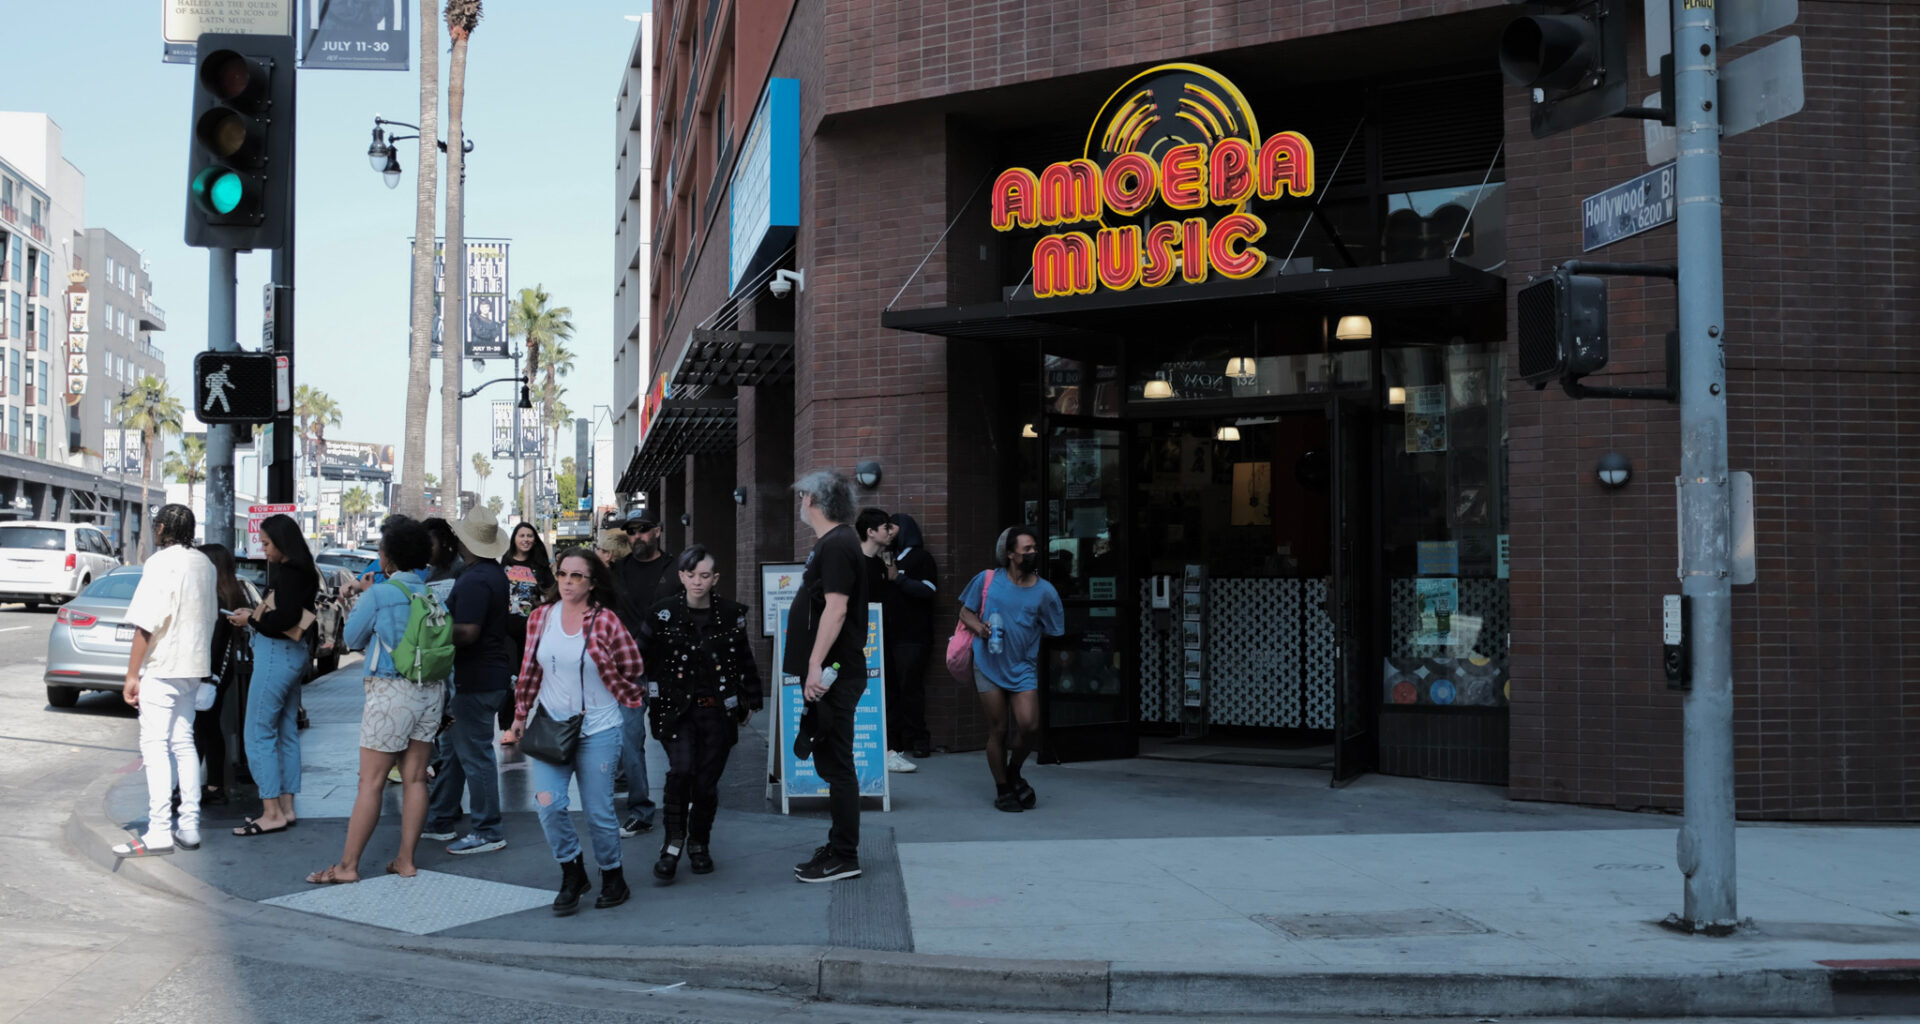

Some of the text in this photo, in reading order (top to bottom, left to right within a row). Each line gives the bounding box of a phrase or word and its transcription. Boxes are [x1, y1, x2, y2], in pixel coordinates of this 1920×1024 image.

[247, 1, 278, 9] QUEEN
[322, 41, 390, 52] JULY 11-30
[991, 131, 1315, 231] AMOEBA
[1585, 168, 1675, 229] Hollywood Bl
[1638, 197, 1675, 228] 6200 W
[1033, 213, 1267, 298] MUSIC
[72, 295, 85, 395] FUNKO
